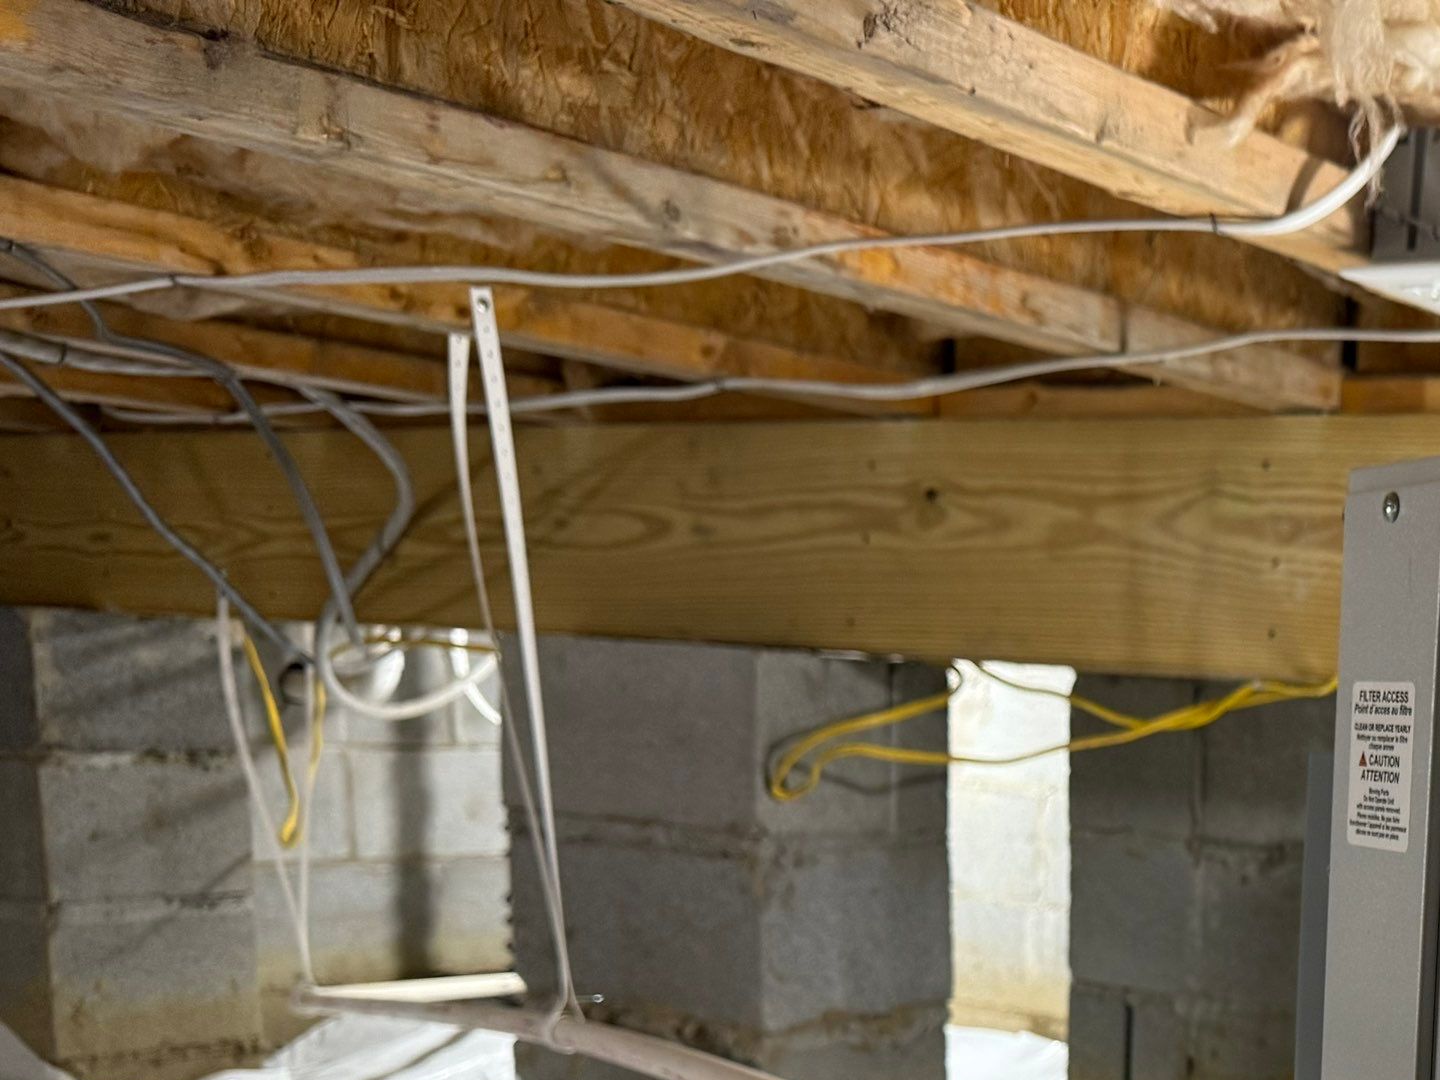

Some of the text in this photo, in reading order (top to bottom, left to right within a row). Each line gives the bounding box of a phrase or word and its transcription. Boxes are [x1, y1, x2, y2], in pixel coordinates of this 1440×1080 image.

[1359, 690, 1409, 703] FILTER ACCESS
[1375, 723, 1394, 733] REPLACE
[1369, 754, 1400, 767] CAUTION
[1361, 769, 1400, 784] ATTENTION
